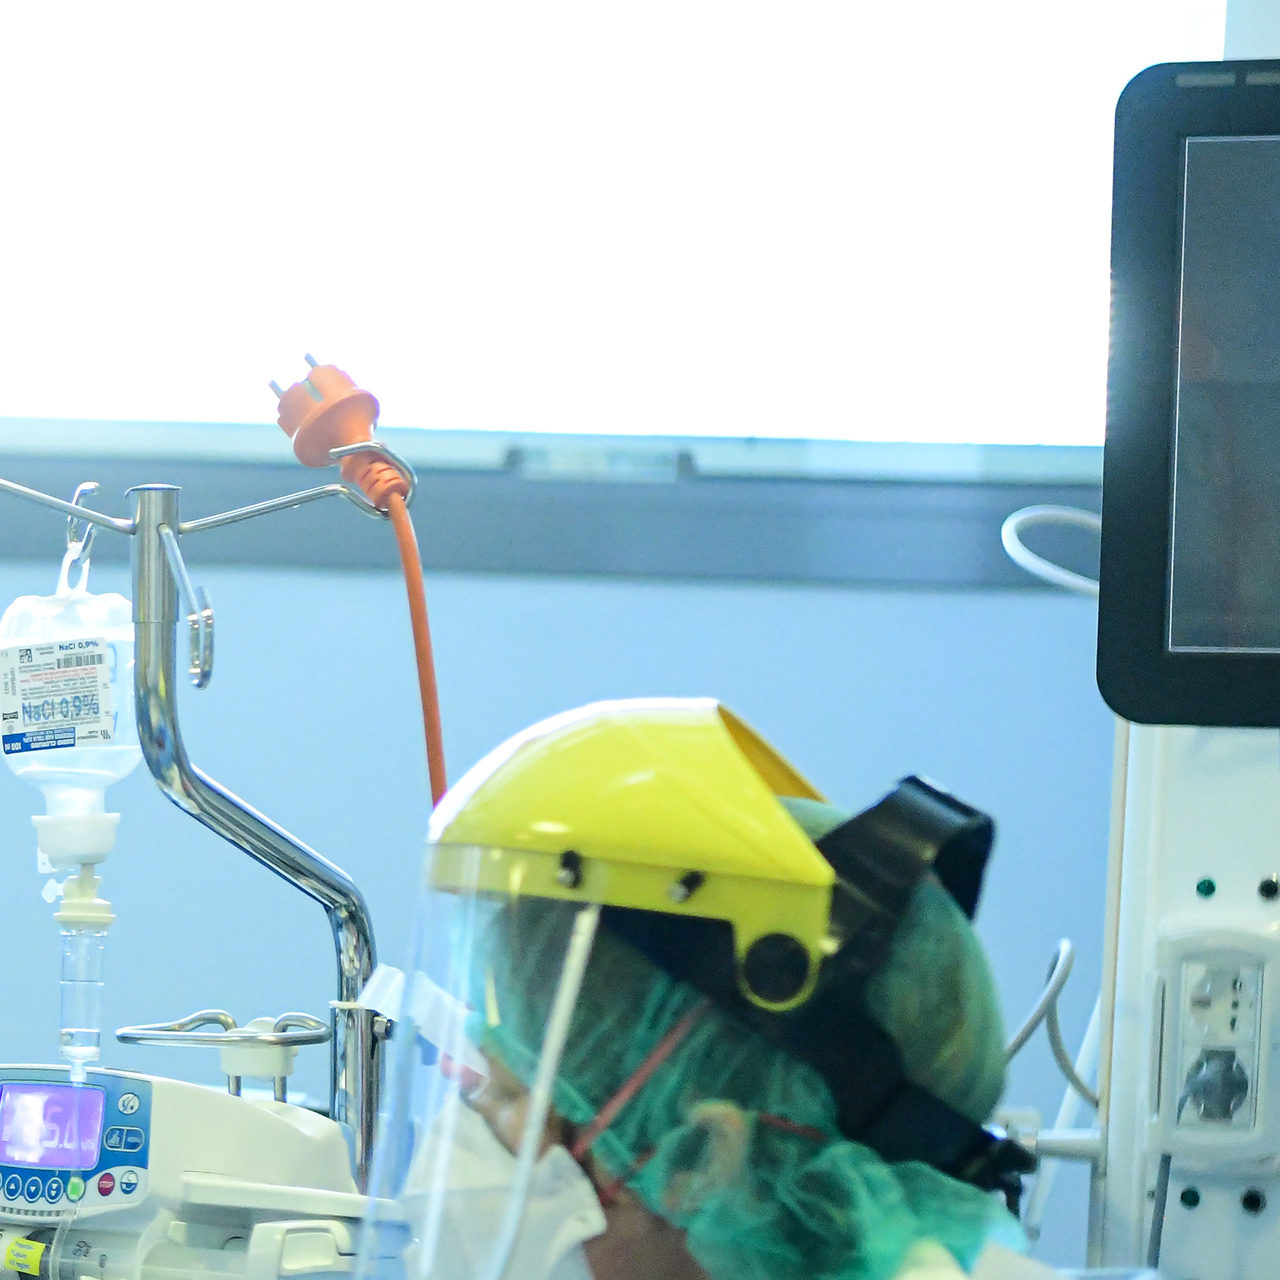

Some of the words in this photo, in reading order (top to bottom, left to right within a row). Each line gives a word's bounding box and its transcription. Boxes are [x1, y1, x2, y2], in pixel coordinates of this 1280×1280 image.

[58, 643, 75, 651] NaCl
[22, 699, 55, 724] NaCl
[99, 1180, 114, 1188] STOP
